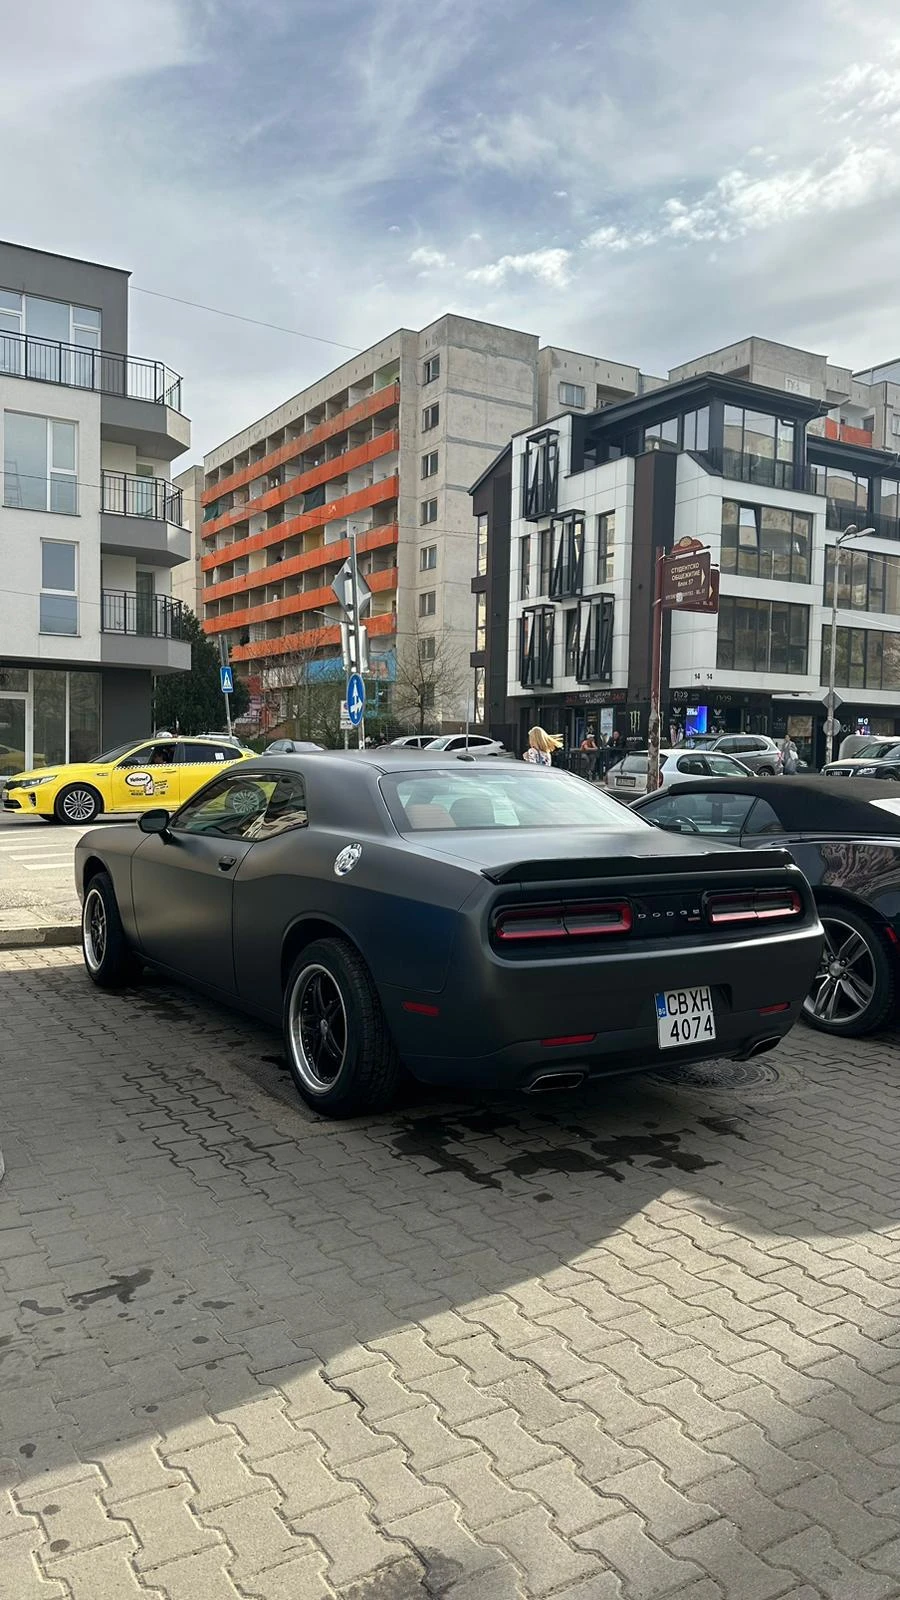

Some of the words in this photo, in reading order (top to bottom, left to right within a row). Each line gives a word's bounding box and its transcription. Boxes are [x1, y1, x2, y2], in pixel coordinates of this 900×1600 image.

[671, 562, 699, 574] СТУДЕНТСКО
[672, 569, 701, 581] ОБЩЕЖИТИЕ
[638, 909, 700, 918] DODGE
[658, 1007, 666, 1016] BG
[670, 1014, 713, 1042] 4074
